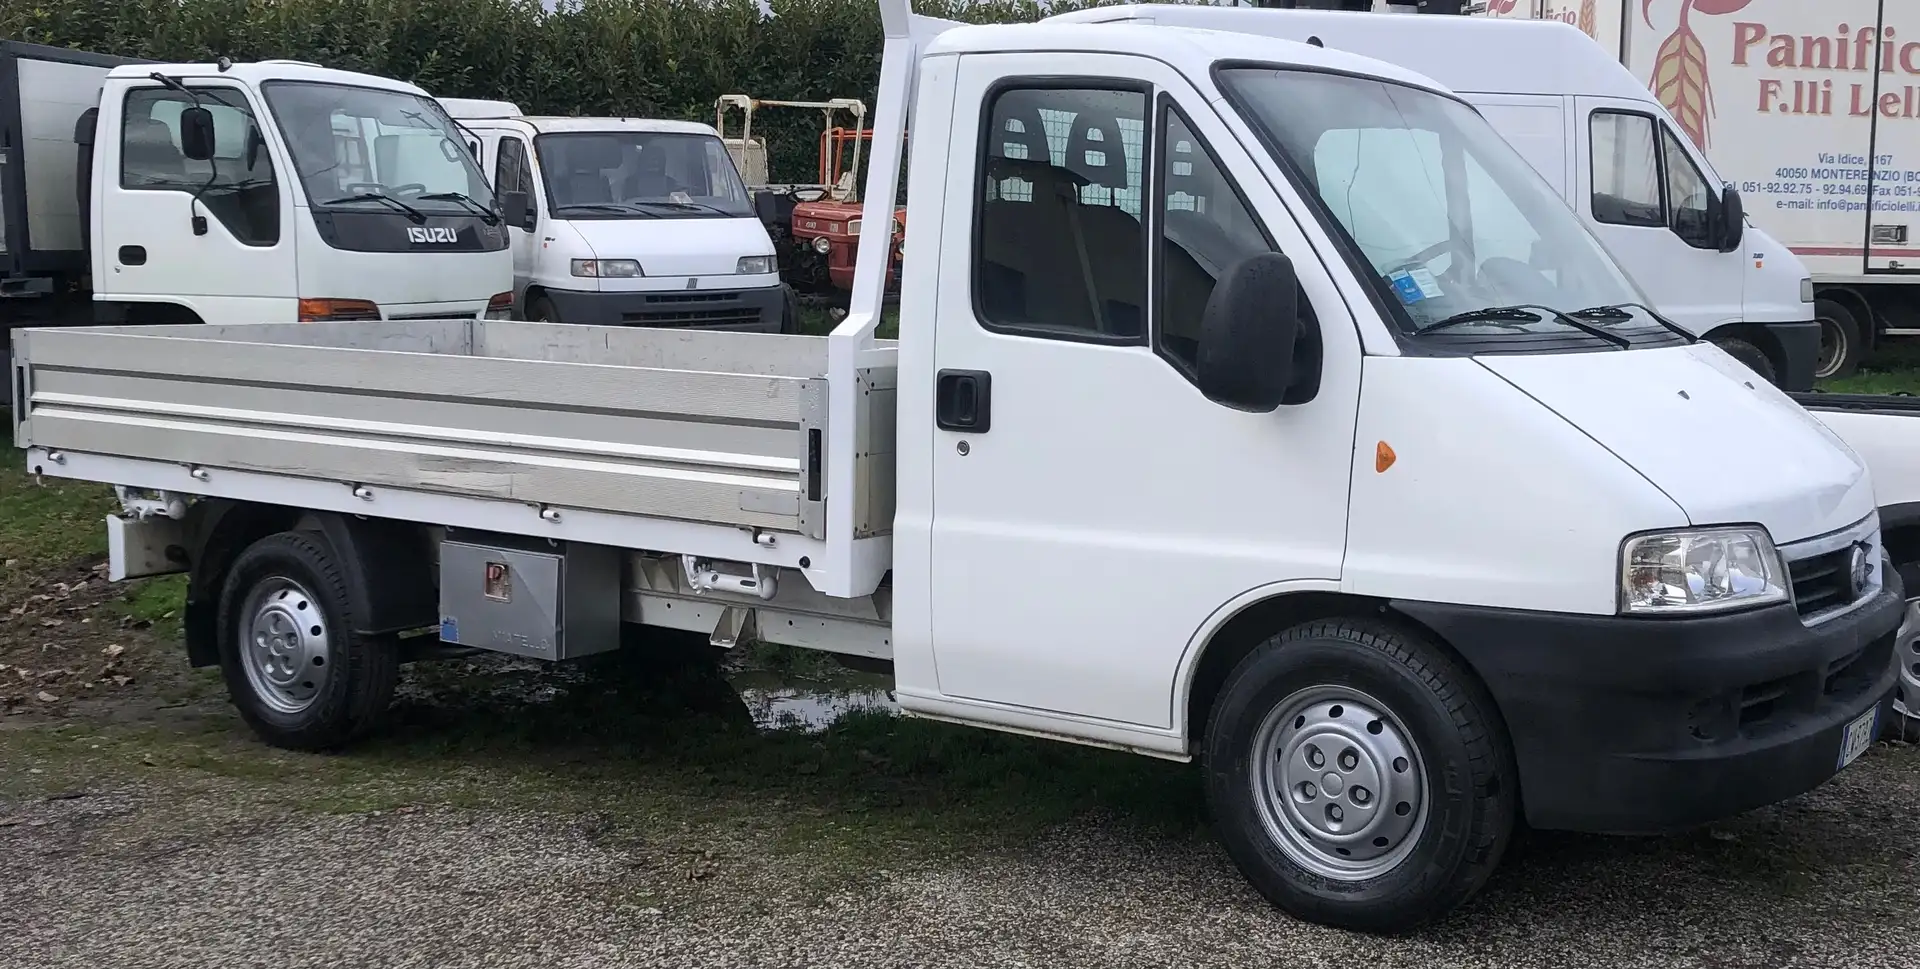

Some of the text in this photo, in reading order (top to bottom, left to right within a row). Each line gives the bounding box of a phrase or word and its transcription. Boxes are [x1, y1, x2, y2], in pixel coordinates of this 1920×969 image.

[1757, 79, 1832, 114] F.lli
[1818, 153, 1893, 166] Via Idice, 167
[1775, 168, 1808, 179] 40050
[1811, 168, 1900, 181] MONTERENZIO
[1743, 181, 1812, 194] 051-92.92.75
[1872, 185, 1891, 196] Fax
[1776, 199, 1814, 210] e-mail:
[406, 227, 458, 243] ISUZU
